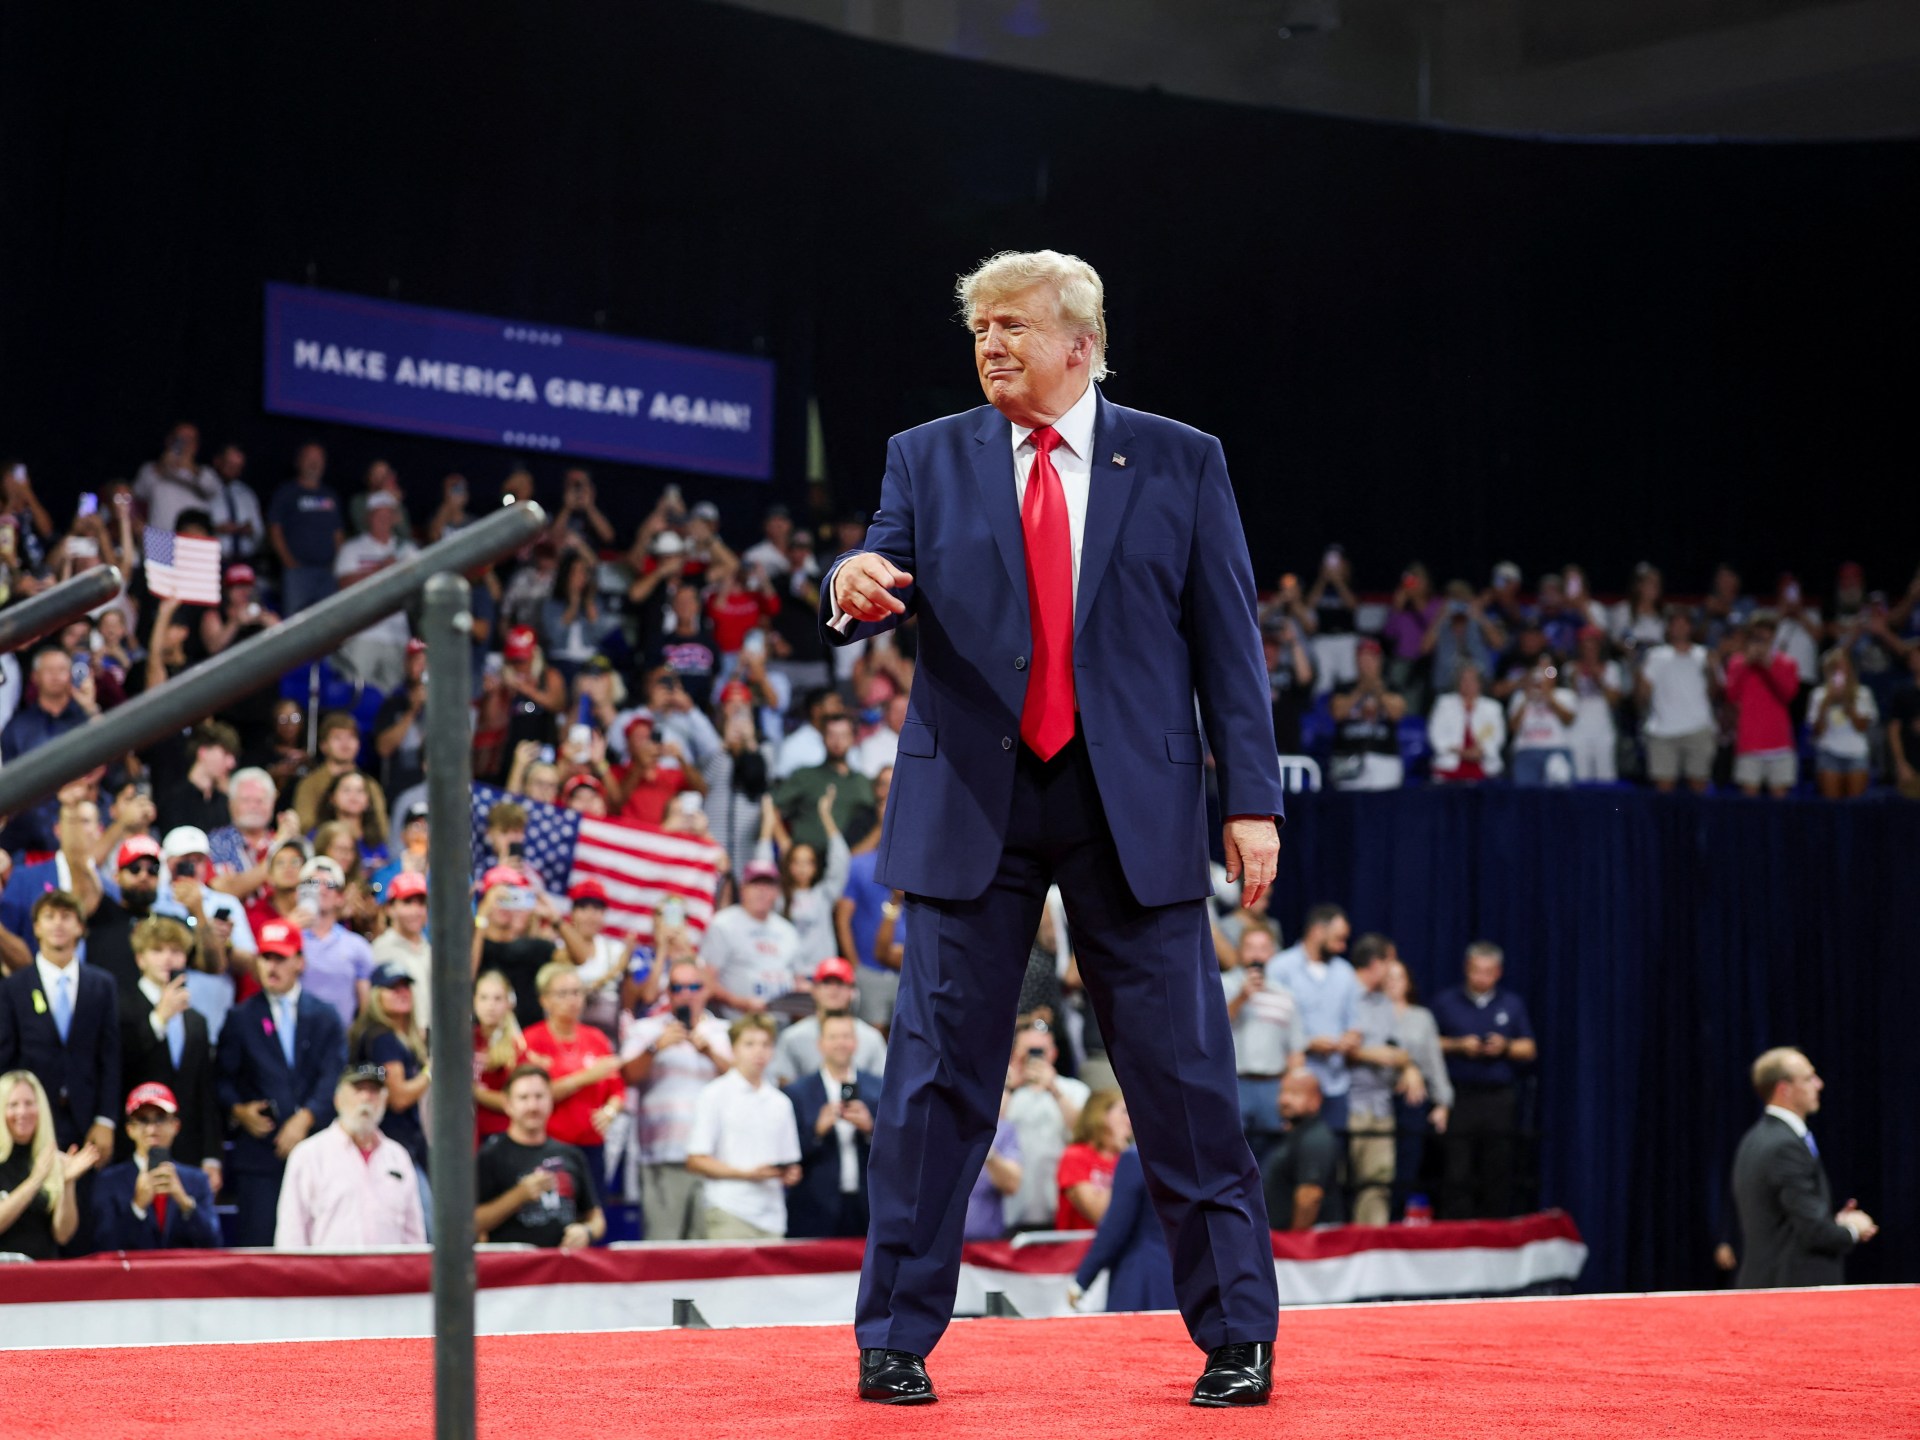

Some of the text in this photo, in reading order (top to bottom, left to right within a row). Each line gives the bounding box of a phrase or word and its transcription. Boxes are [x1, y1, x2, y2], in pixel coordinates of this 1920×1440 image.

[293, 340, 751, 431] MAKE AMERICA GREAT AGAIN!
